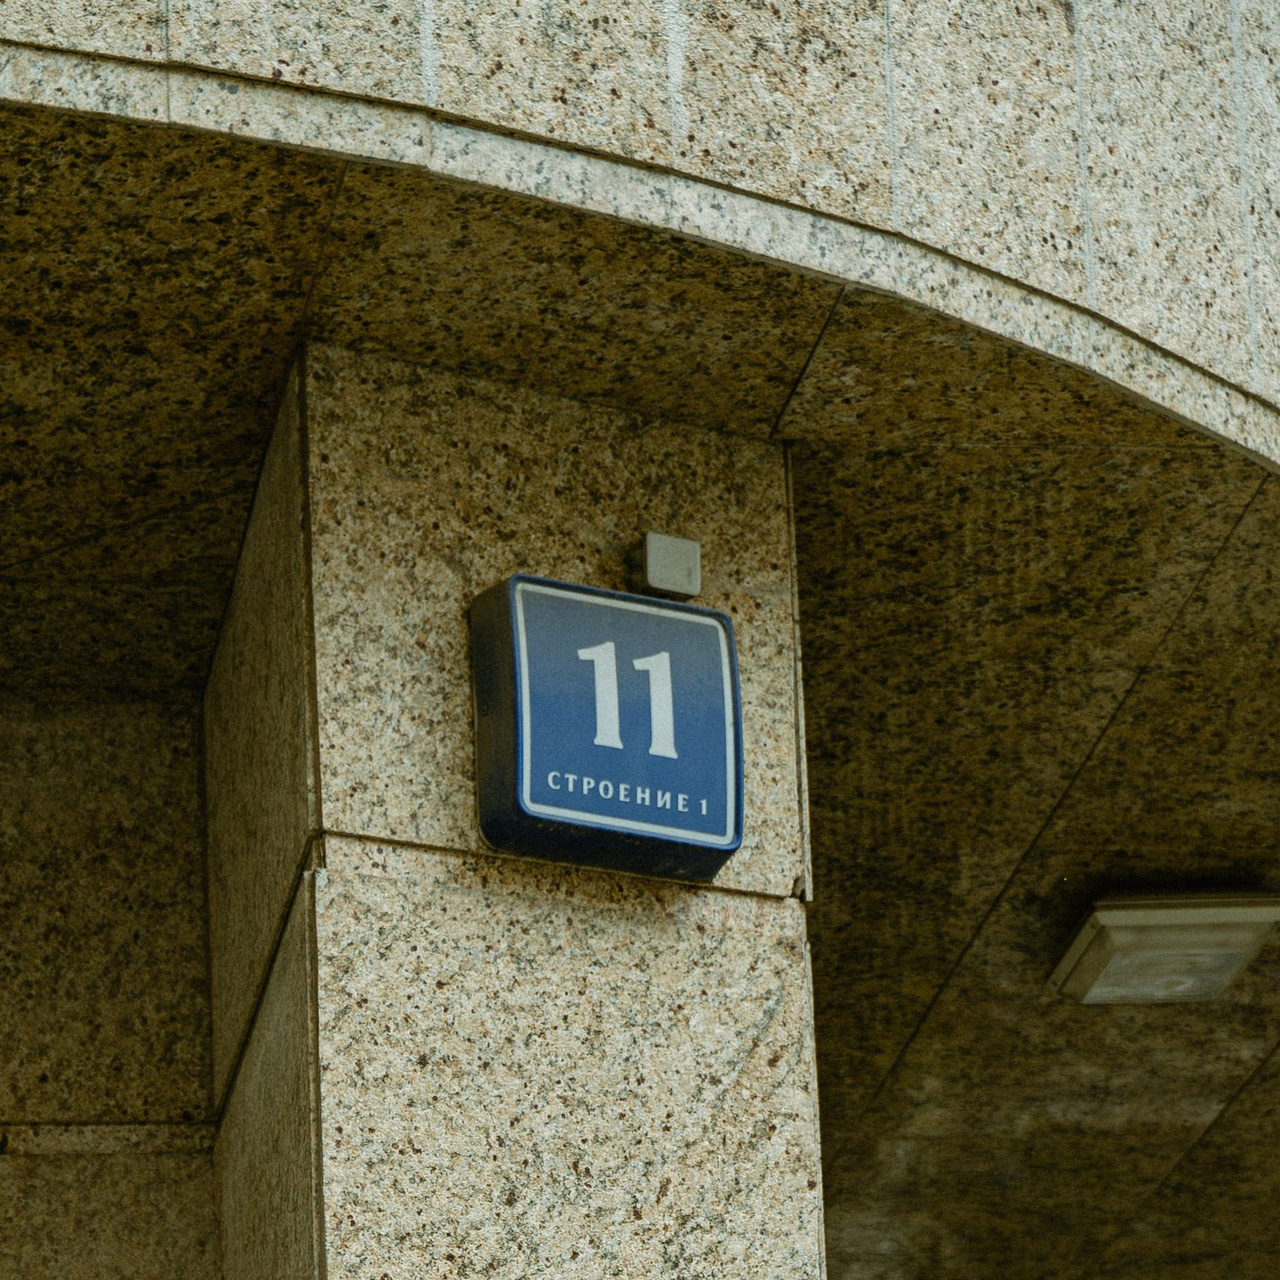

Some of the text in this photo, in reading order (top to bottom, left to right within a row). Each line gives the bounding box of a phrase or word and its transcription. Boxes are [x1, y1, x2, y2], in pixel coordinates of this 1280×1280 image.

[576, 640, 679, 760] 11
[546, 770, 709, 816] СТРОЕНИЕ 1
